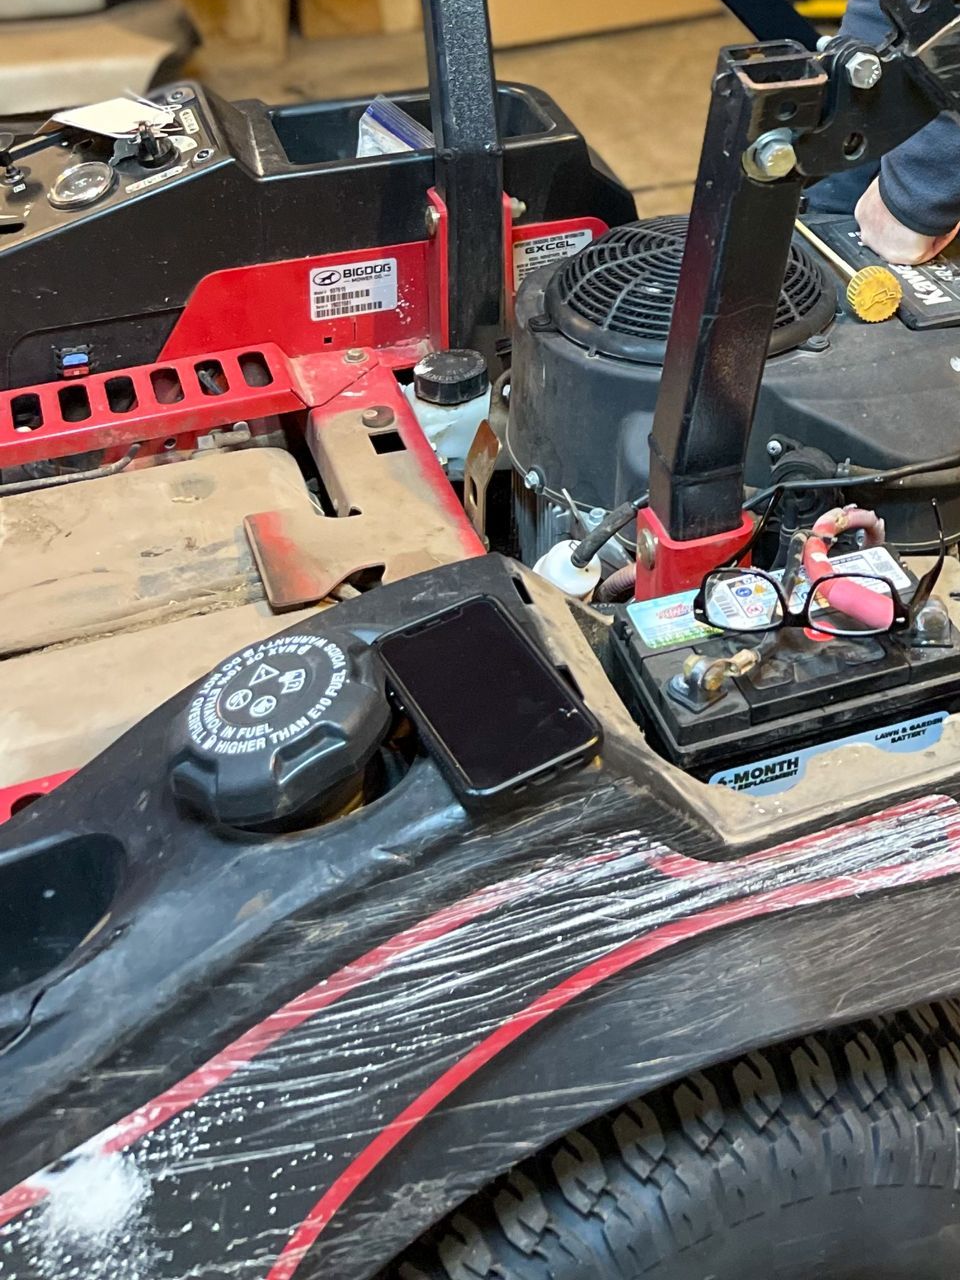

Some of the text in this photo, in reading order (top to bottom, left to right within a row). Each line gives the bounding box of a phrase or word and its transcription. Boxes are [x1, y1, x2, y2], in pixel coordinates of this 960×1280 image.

[524, 239, 576, 255] EXCEL
[343, 263, 391, 278] BIGDOG
[268, 644, 299, 656] MAX
[188, 635, 346, 754] DO NOT OVERFILL HIGHER THAN E10 FUEL VOIDS WARRANTY
[203, 688, 222, 733] ETHANOL
[220, 725, 236, 738] IN
[237, 723, 273, 739] FUEL
[874, 729, 899, 740] LAWN
[890, 728, 927, 743] BATTERY
[737, 769, 798, 790] REPLACEMENT
